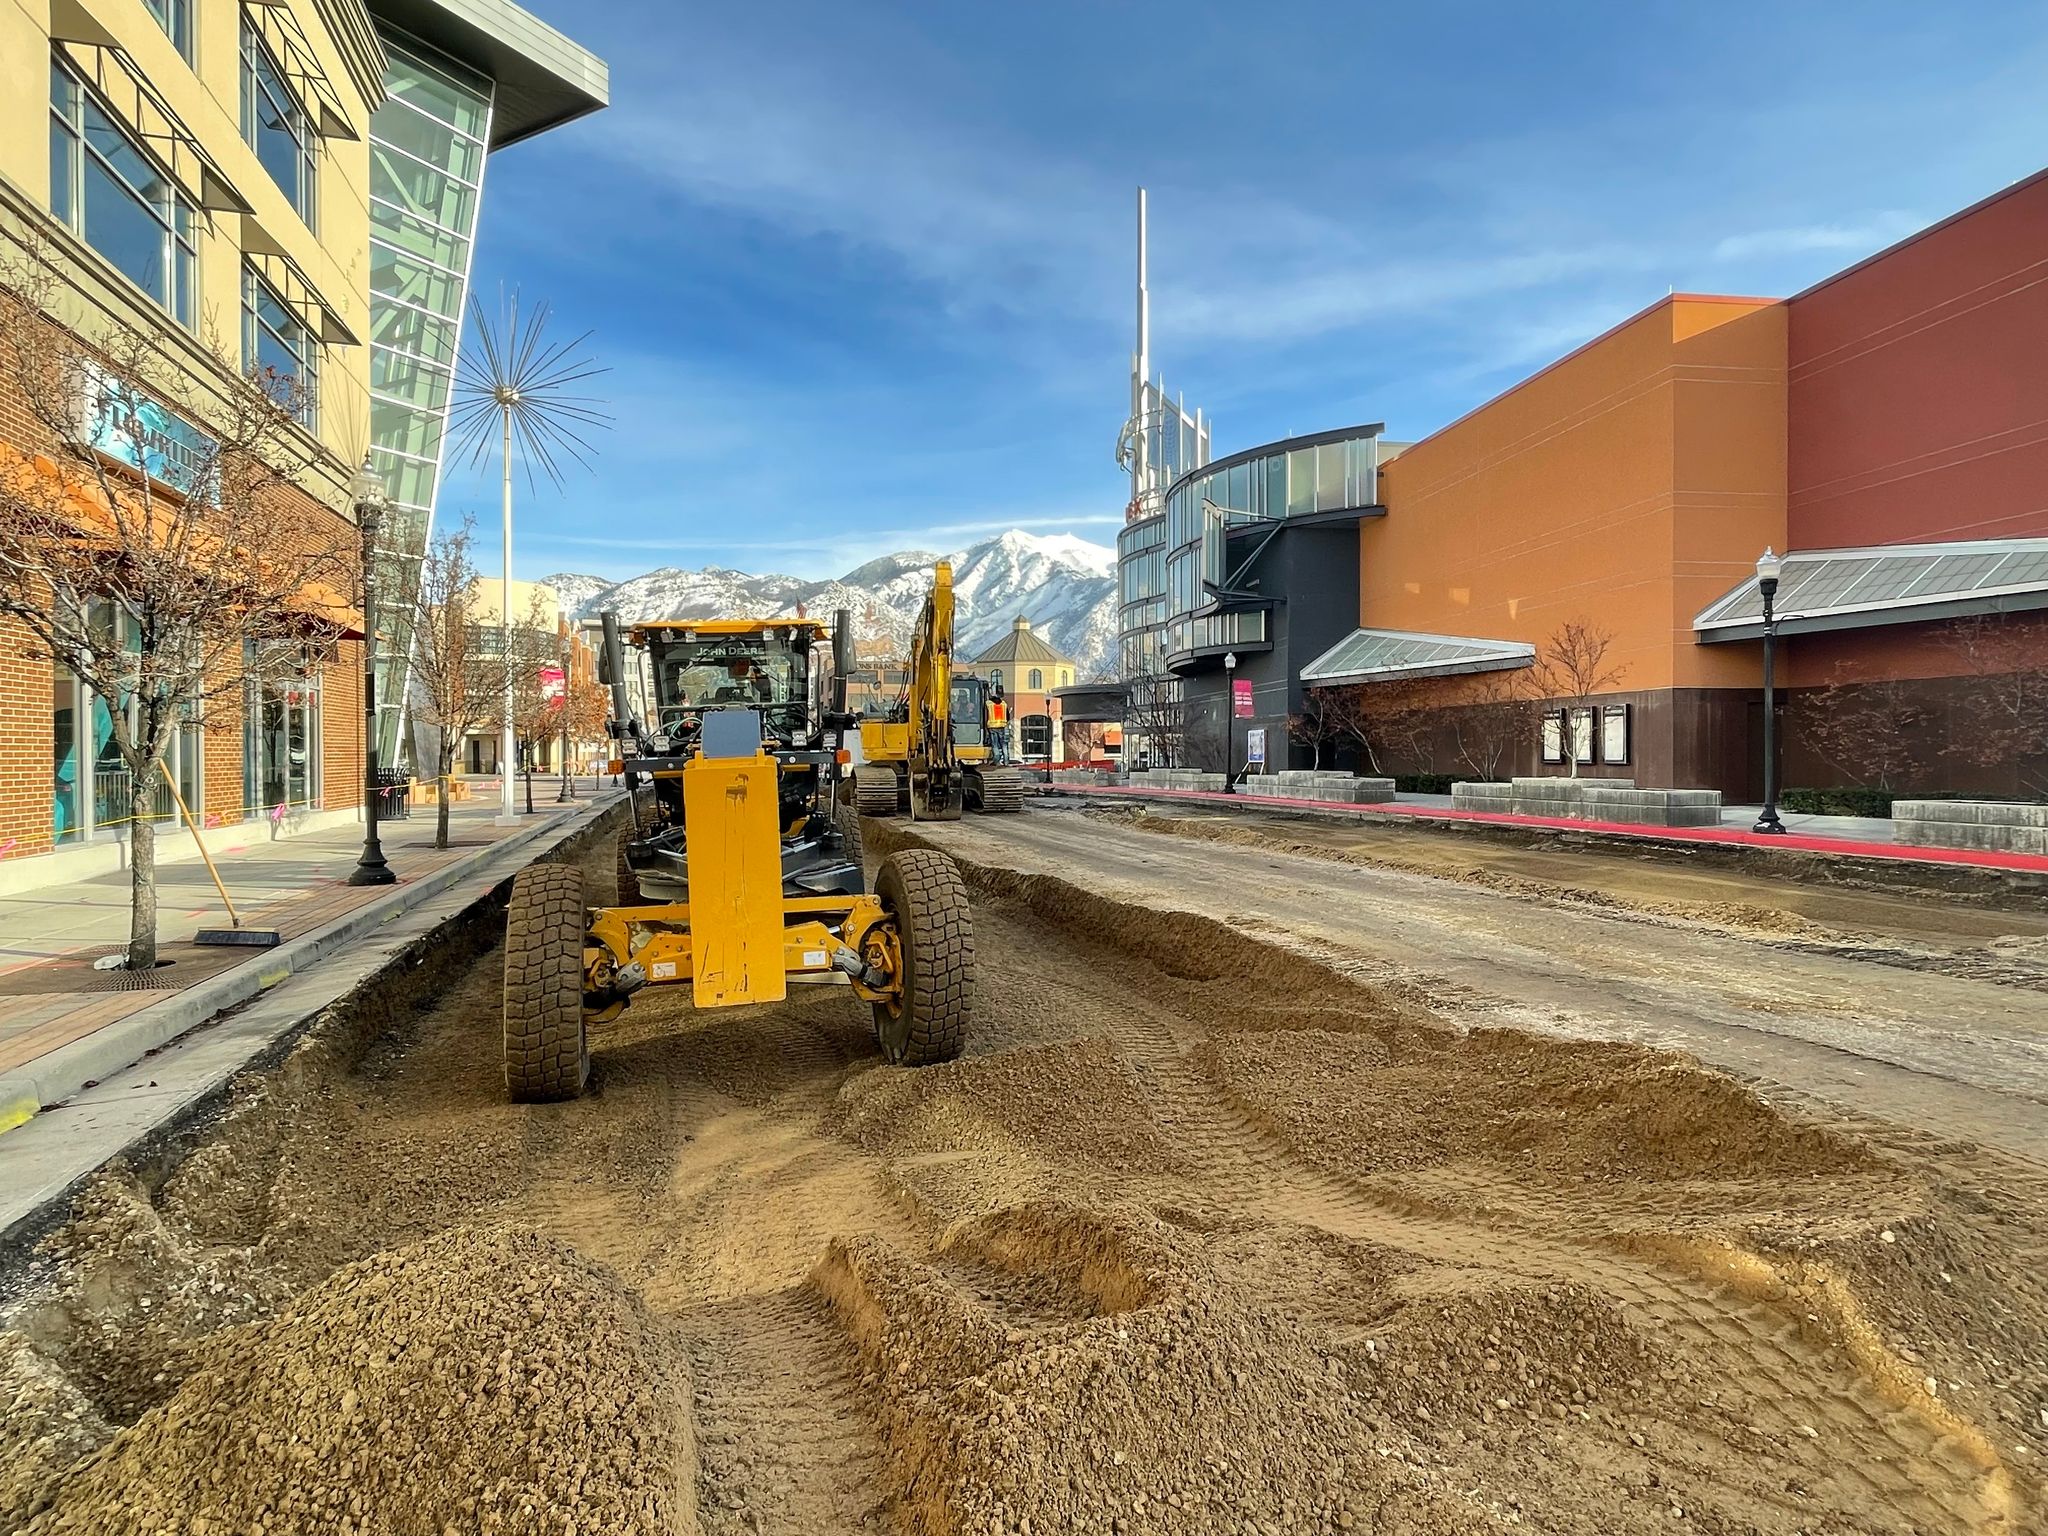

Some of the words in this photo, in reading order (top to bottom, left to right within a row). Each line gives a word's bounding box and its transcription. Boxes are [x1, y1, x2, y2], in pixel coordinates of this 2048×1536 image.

[696, 647, 727, 656] JOHN
[728, 647, 765, 656] DEERE
[873, 662, 898, 670] BANK
